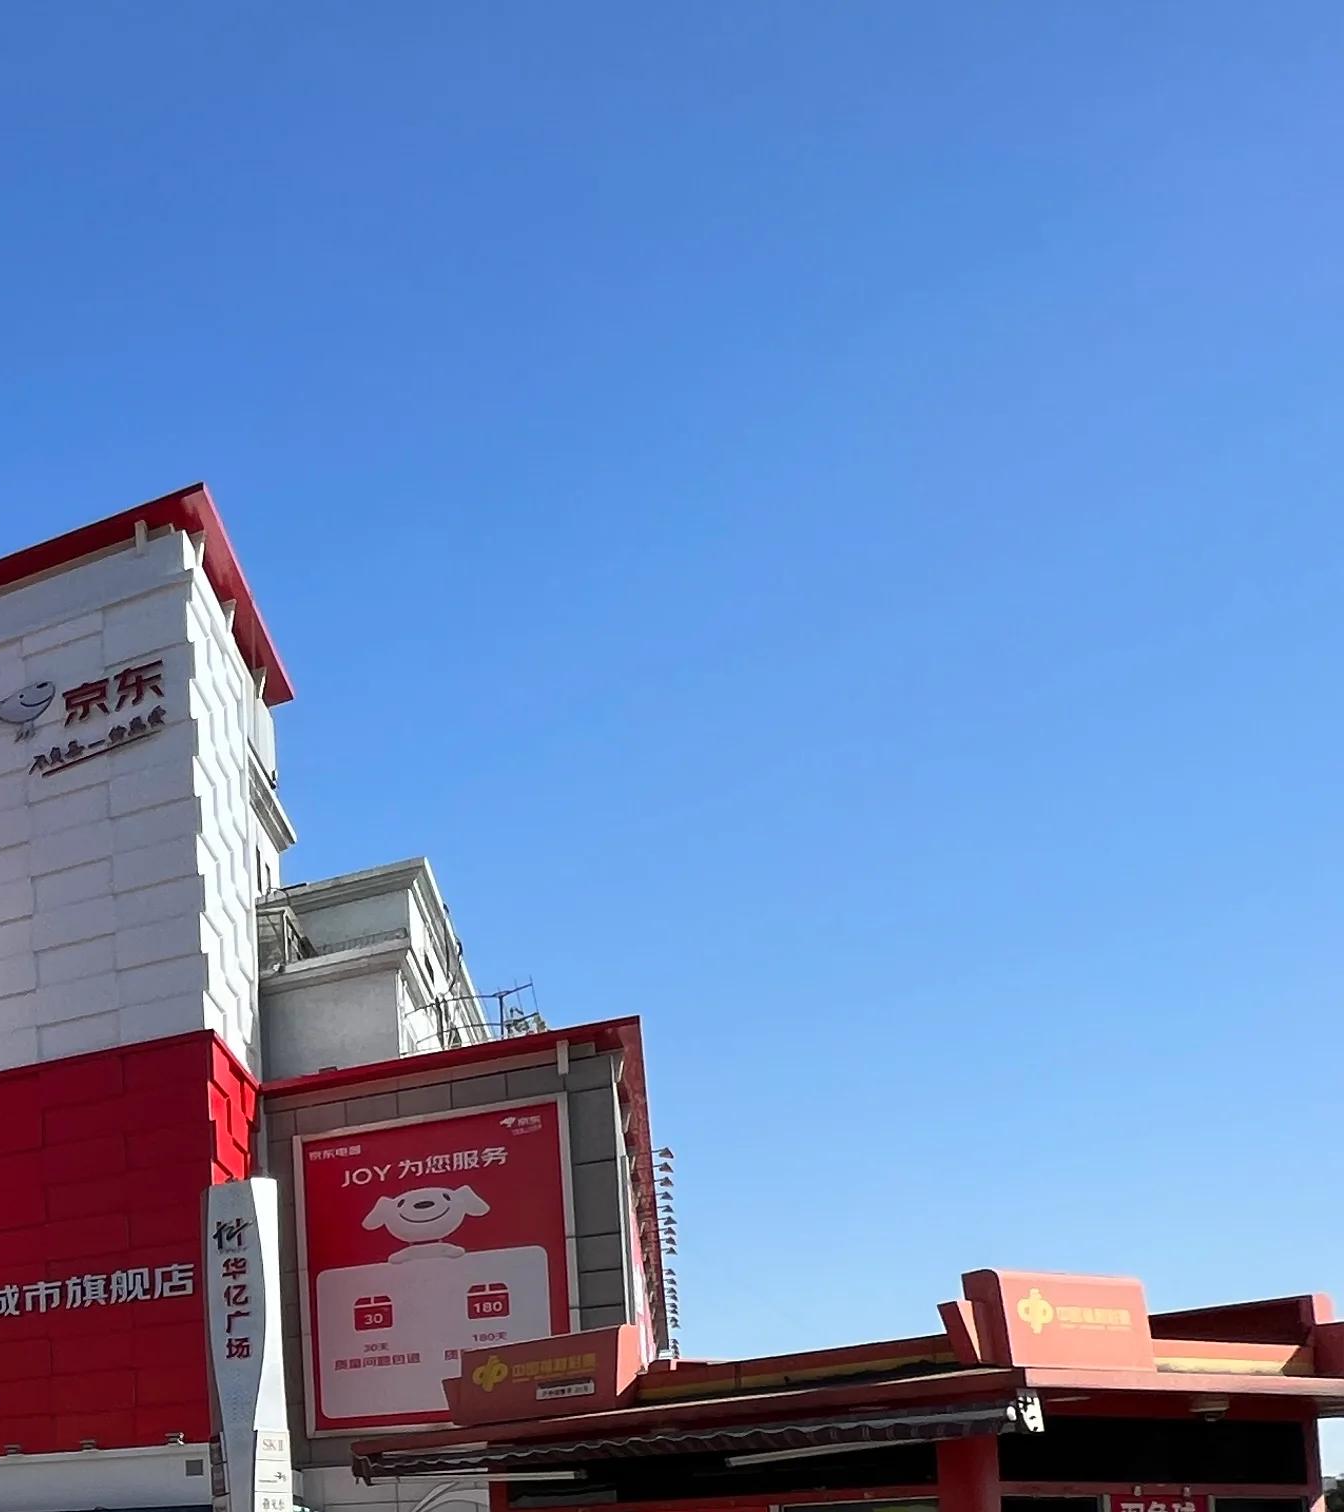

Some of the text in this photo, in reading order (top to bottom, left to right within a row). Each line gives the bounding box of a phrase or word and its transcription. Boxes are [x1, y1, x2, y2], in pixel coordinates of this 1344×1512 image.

[62, 660, 164, 728] 京东
[341, 1146, 509, 1188] JOY 为您服务
[222, 1257, 250, 1359] 华亿广场
[364, 1313, 383, 1325] 30
[473, 1301, 503, 1313] 180
[472, 1331, 507, 1342] 180天
